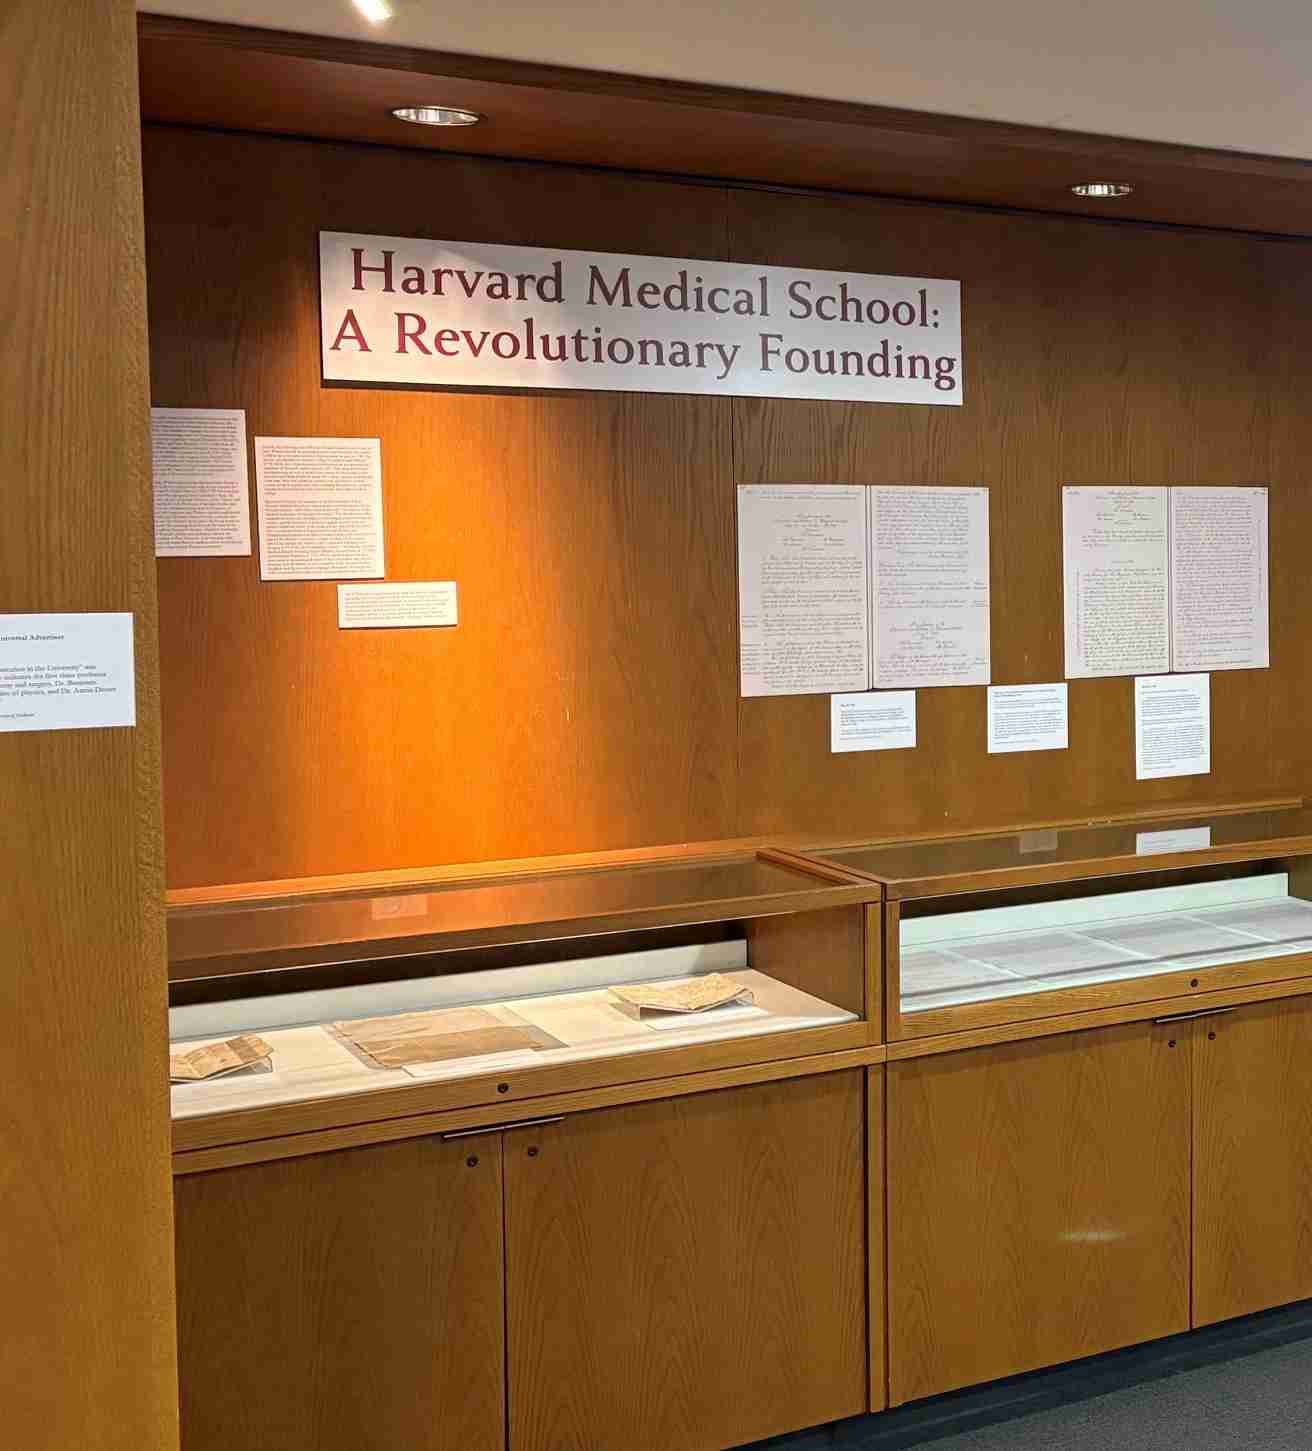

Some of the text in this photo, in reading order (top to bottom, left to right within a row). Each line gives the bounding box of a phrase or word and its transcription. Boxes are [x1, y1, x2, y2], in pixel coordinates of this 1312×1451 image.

[351, 247, 940, 329] Harvard Medical School:
[329, 308, 957, 392] A Revolutionary Founding
